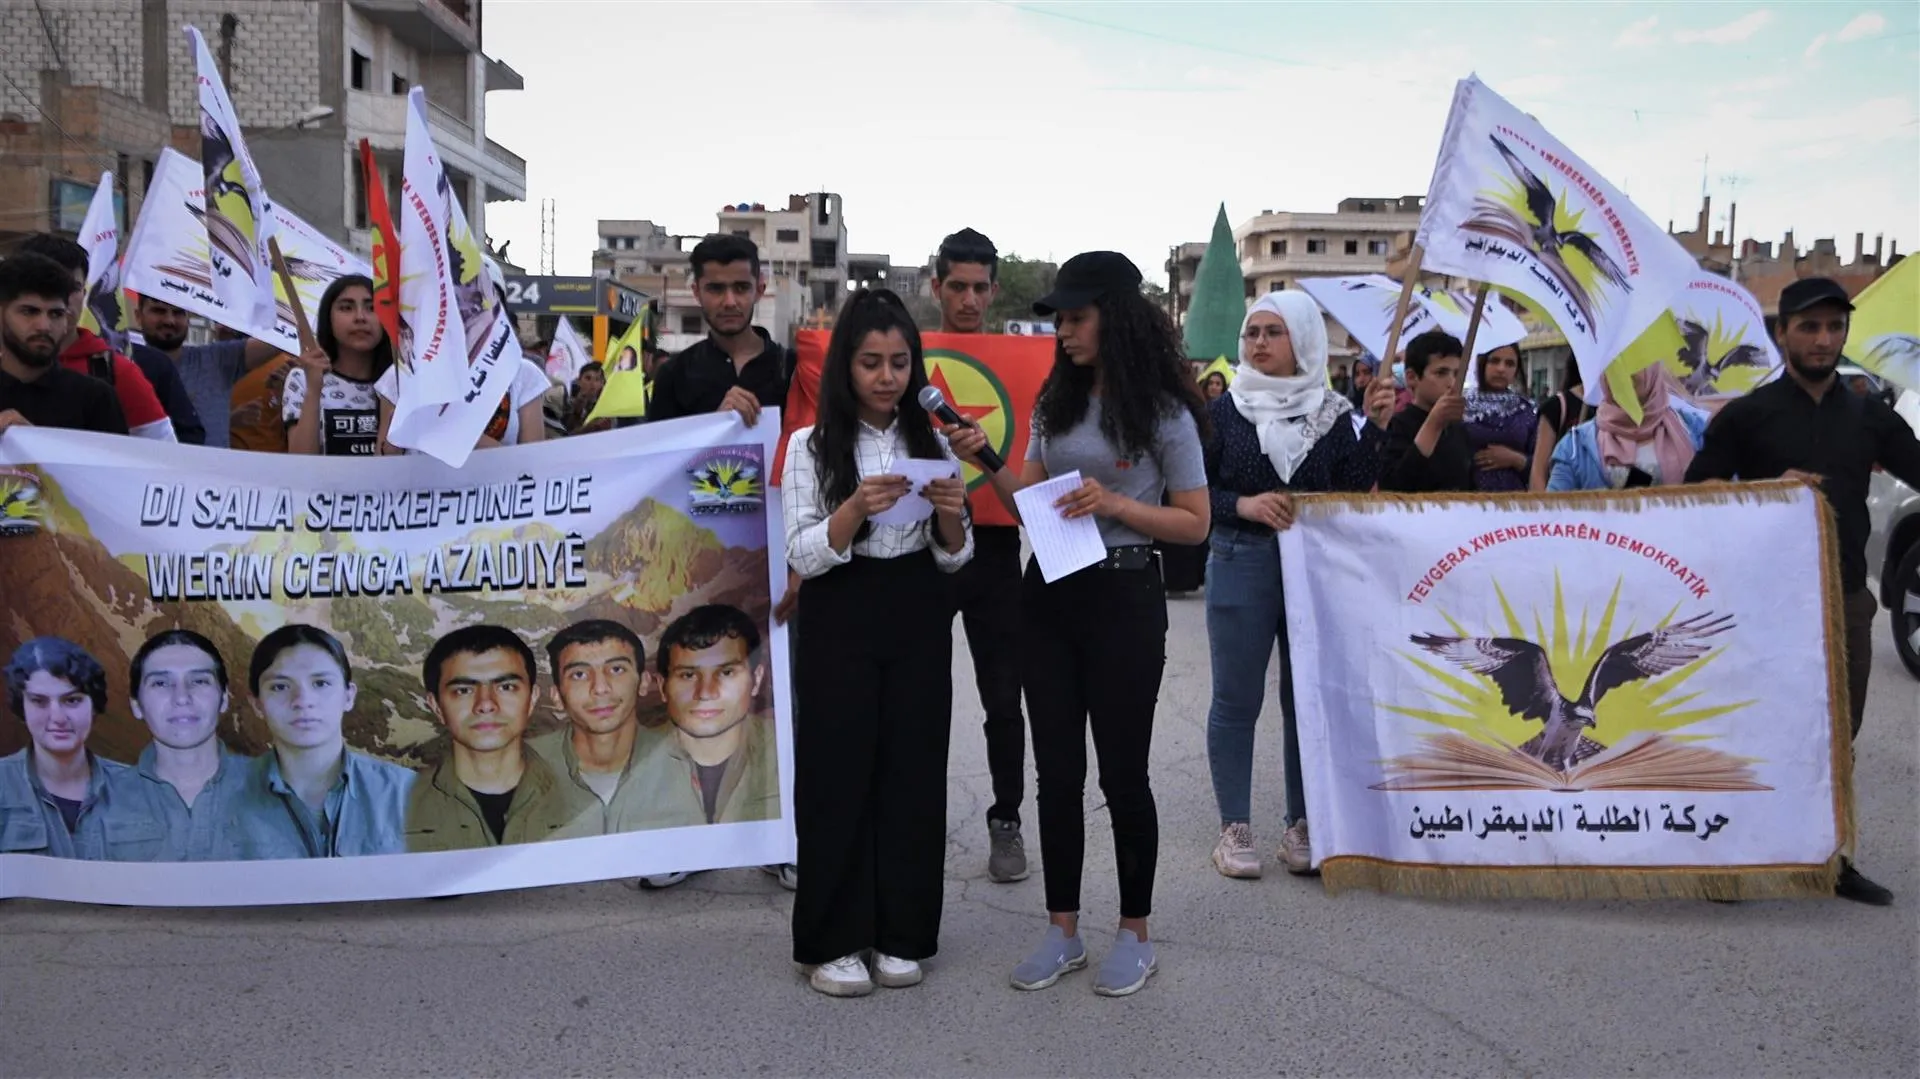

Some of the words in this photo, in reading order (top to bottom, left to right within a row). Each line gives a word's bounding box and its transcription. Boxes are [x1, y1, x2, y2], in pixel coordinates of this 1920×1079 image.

[350, 441, 377, 454] cut
[141, 483, 184, 528] DI
[191, 486, 294, 533] SALA
[305, 474, 536, 533] SERKEFTINÊ
[544, 473, 592, 515] DE
[145, 550, 273, 602] WERIN
[282, 549, 412, 599] CENGA
[422, 532, 587, 593] AZADIYÊ
[1407, 546, 1471, 604] TEVGERA
[1469, 523, 1600, 553] XWENDEKARÊN
[1409, 804, 1564, 842] الديمقراطيين
[1571, 803, 1651, 842] الطلبة
[1659, 803, 1730, 841] حركة
